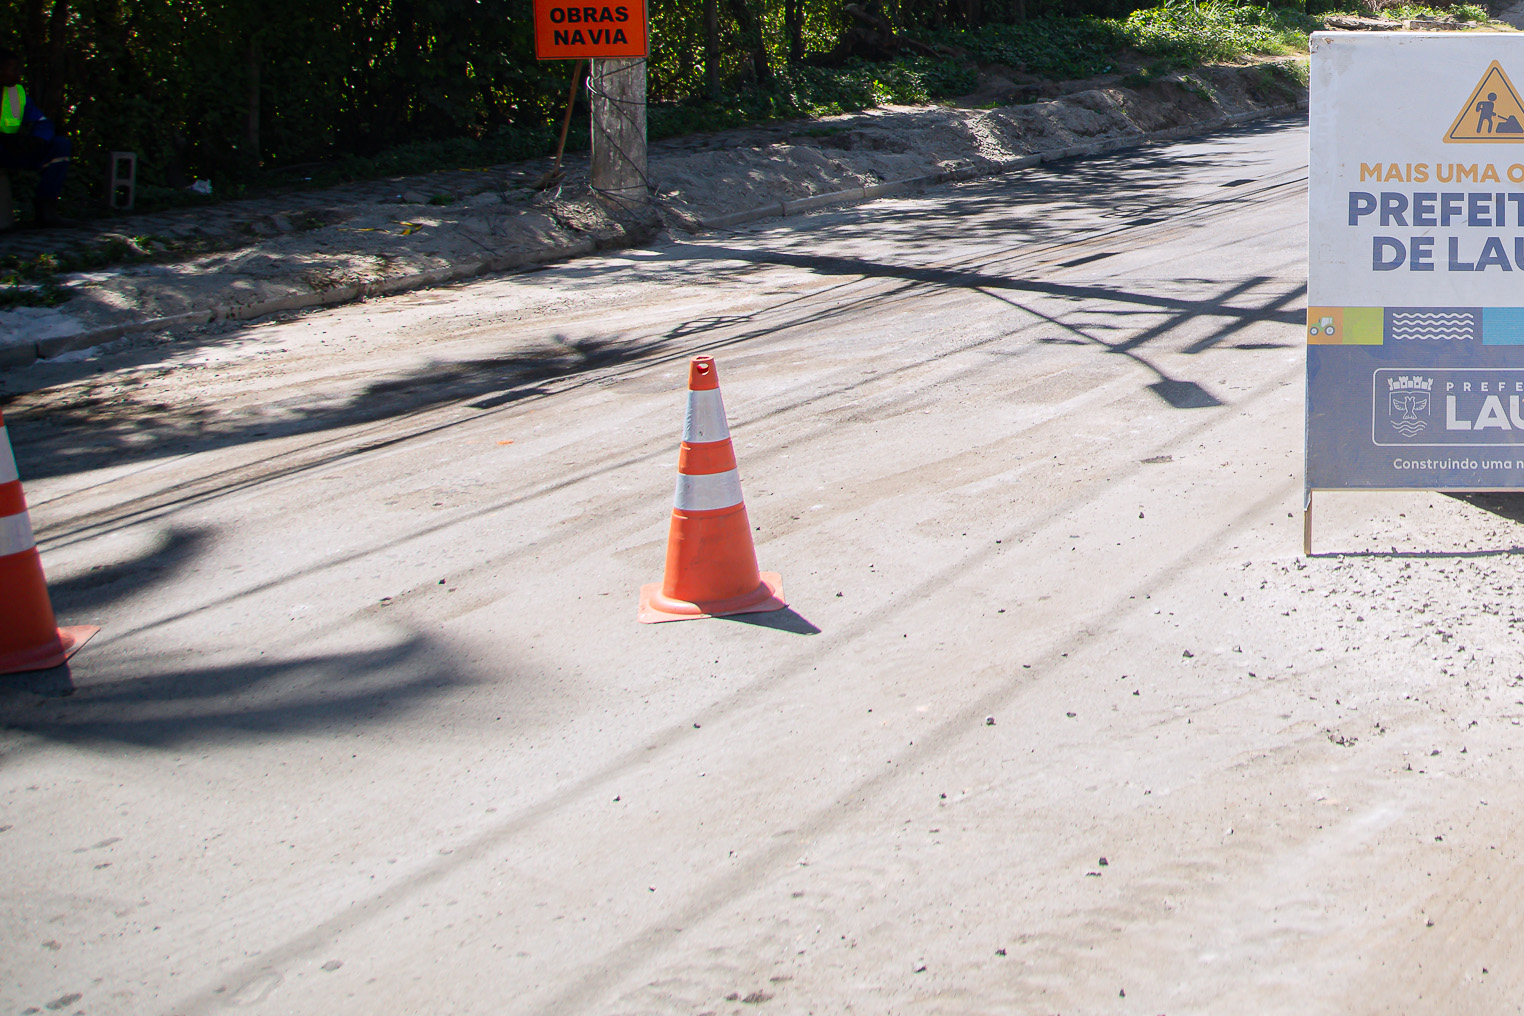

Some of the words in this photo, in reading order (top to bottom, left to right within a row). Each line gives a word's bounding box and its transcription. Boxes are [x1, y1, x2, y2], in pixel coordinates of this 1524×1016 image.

[549, 6, 629, 23] OBRAS
[1359, 162, 1429, 183] MAIS
[1436, 163, 1500, 183] UMA
[1372, 236, 1435, 272] DE
[1393, 457, 1479, 471] Construindo
[1481, 460, 1512, 470] uma
